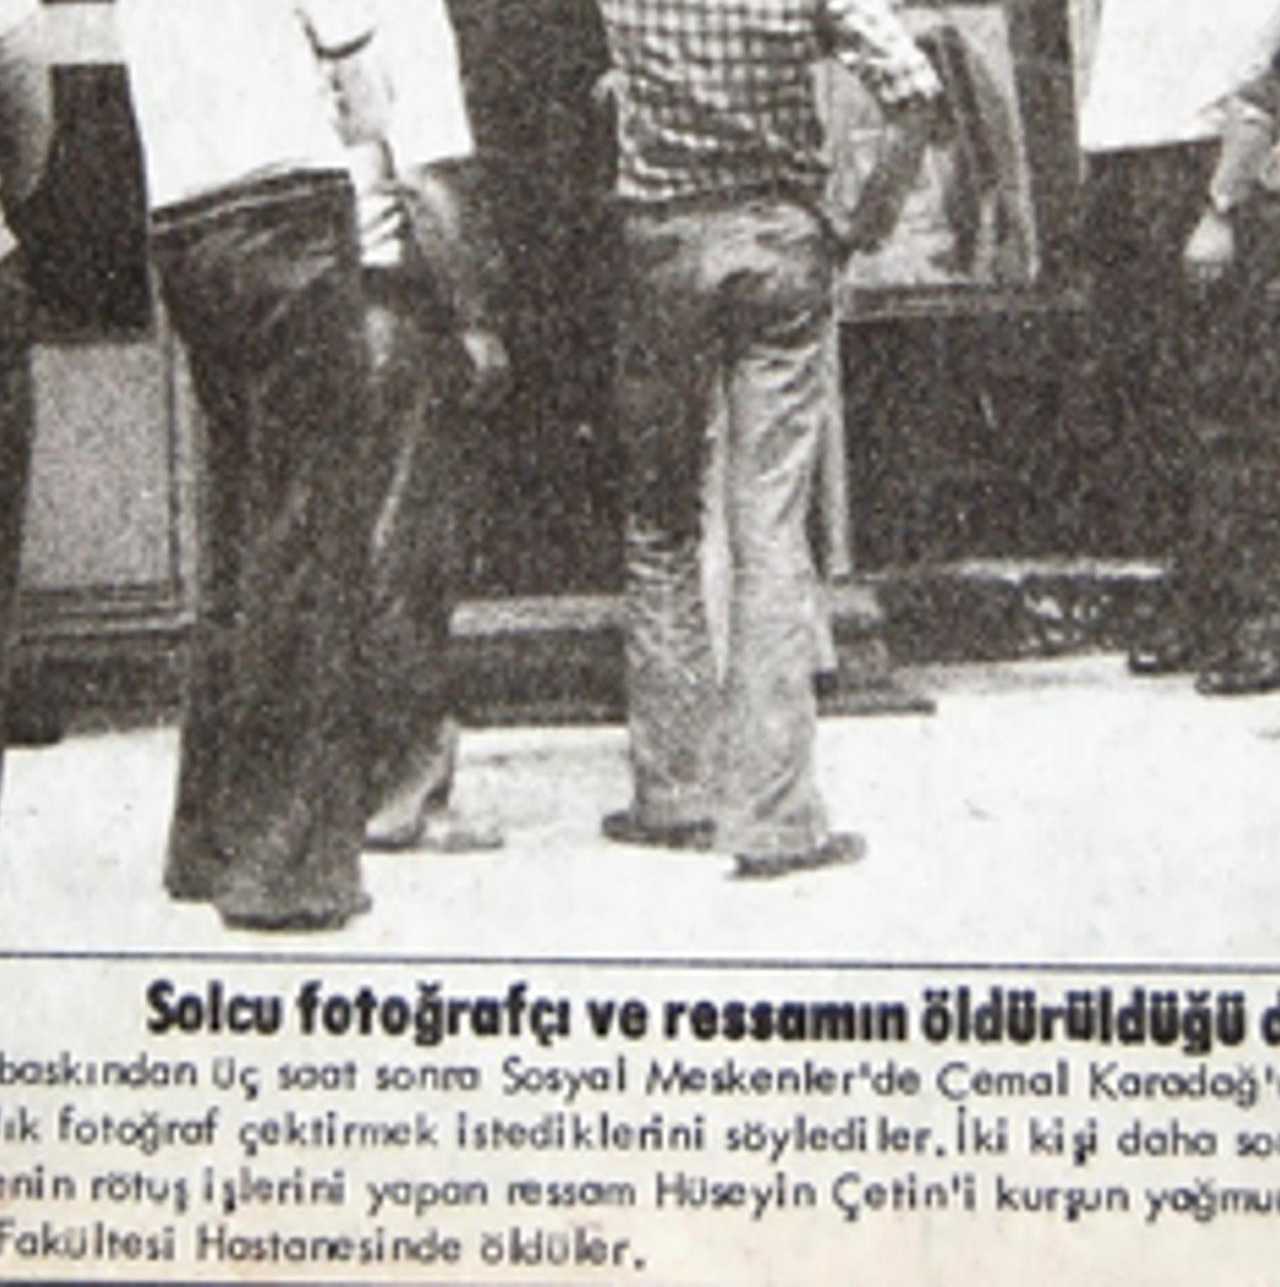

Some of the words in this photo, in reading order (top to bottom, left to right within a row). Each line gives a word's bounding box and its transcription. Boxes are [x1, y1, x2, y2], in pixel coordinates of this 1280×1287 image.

[145, 979, 283, 1037] Solcu
[295, 980, 571, 1048] fotoğrafçı
[585, 999, 649, 1041] ve
[663, 1000, 909, 1043] ressamın
[920, 985, 1247, 1058] öldürüldüğü
[277, 1061, 358, 1092] saat
[375, 1065, 481, 1092] sonra
[501, 1054, 627, 1105] Sosyal
[645, 1059, 921, 1097] Meskenler'de
[58, 1104, 219, 1157] fotoğraf
[237, 1110, 438, 1159] çektirmek
[457, 1111, 705, 1152] istediklerini
[1029, 1117, 1098, 1168] kişi
[1116, 1118, 1218, 1158] daha
[90, 1171, 189, 1216] rötuş
[202, 1166, 345, 1217] işlerini
[365, 1181, 489, 1219] yapan
[506, 1181, 636, 1209] ressam
[655, 1171, 817, 1222] Hüseyin
[831, 1171, 977, 1224] Çetin'i
[995, 1174, 1130, 1223] kurşun
[196, 1224, 462, 1266] Hastanesinde
[479, 1226, 646, 1272] öldüler.
